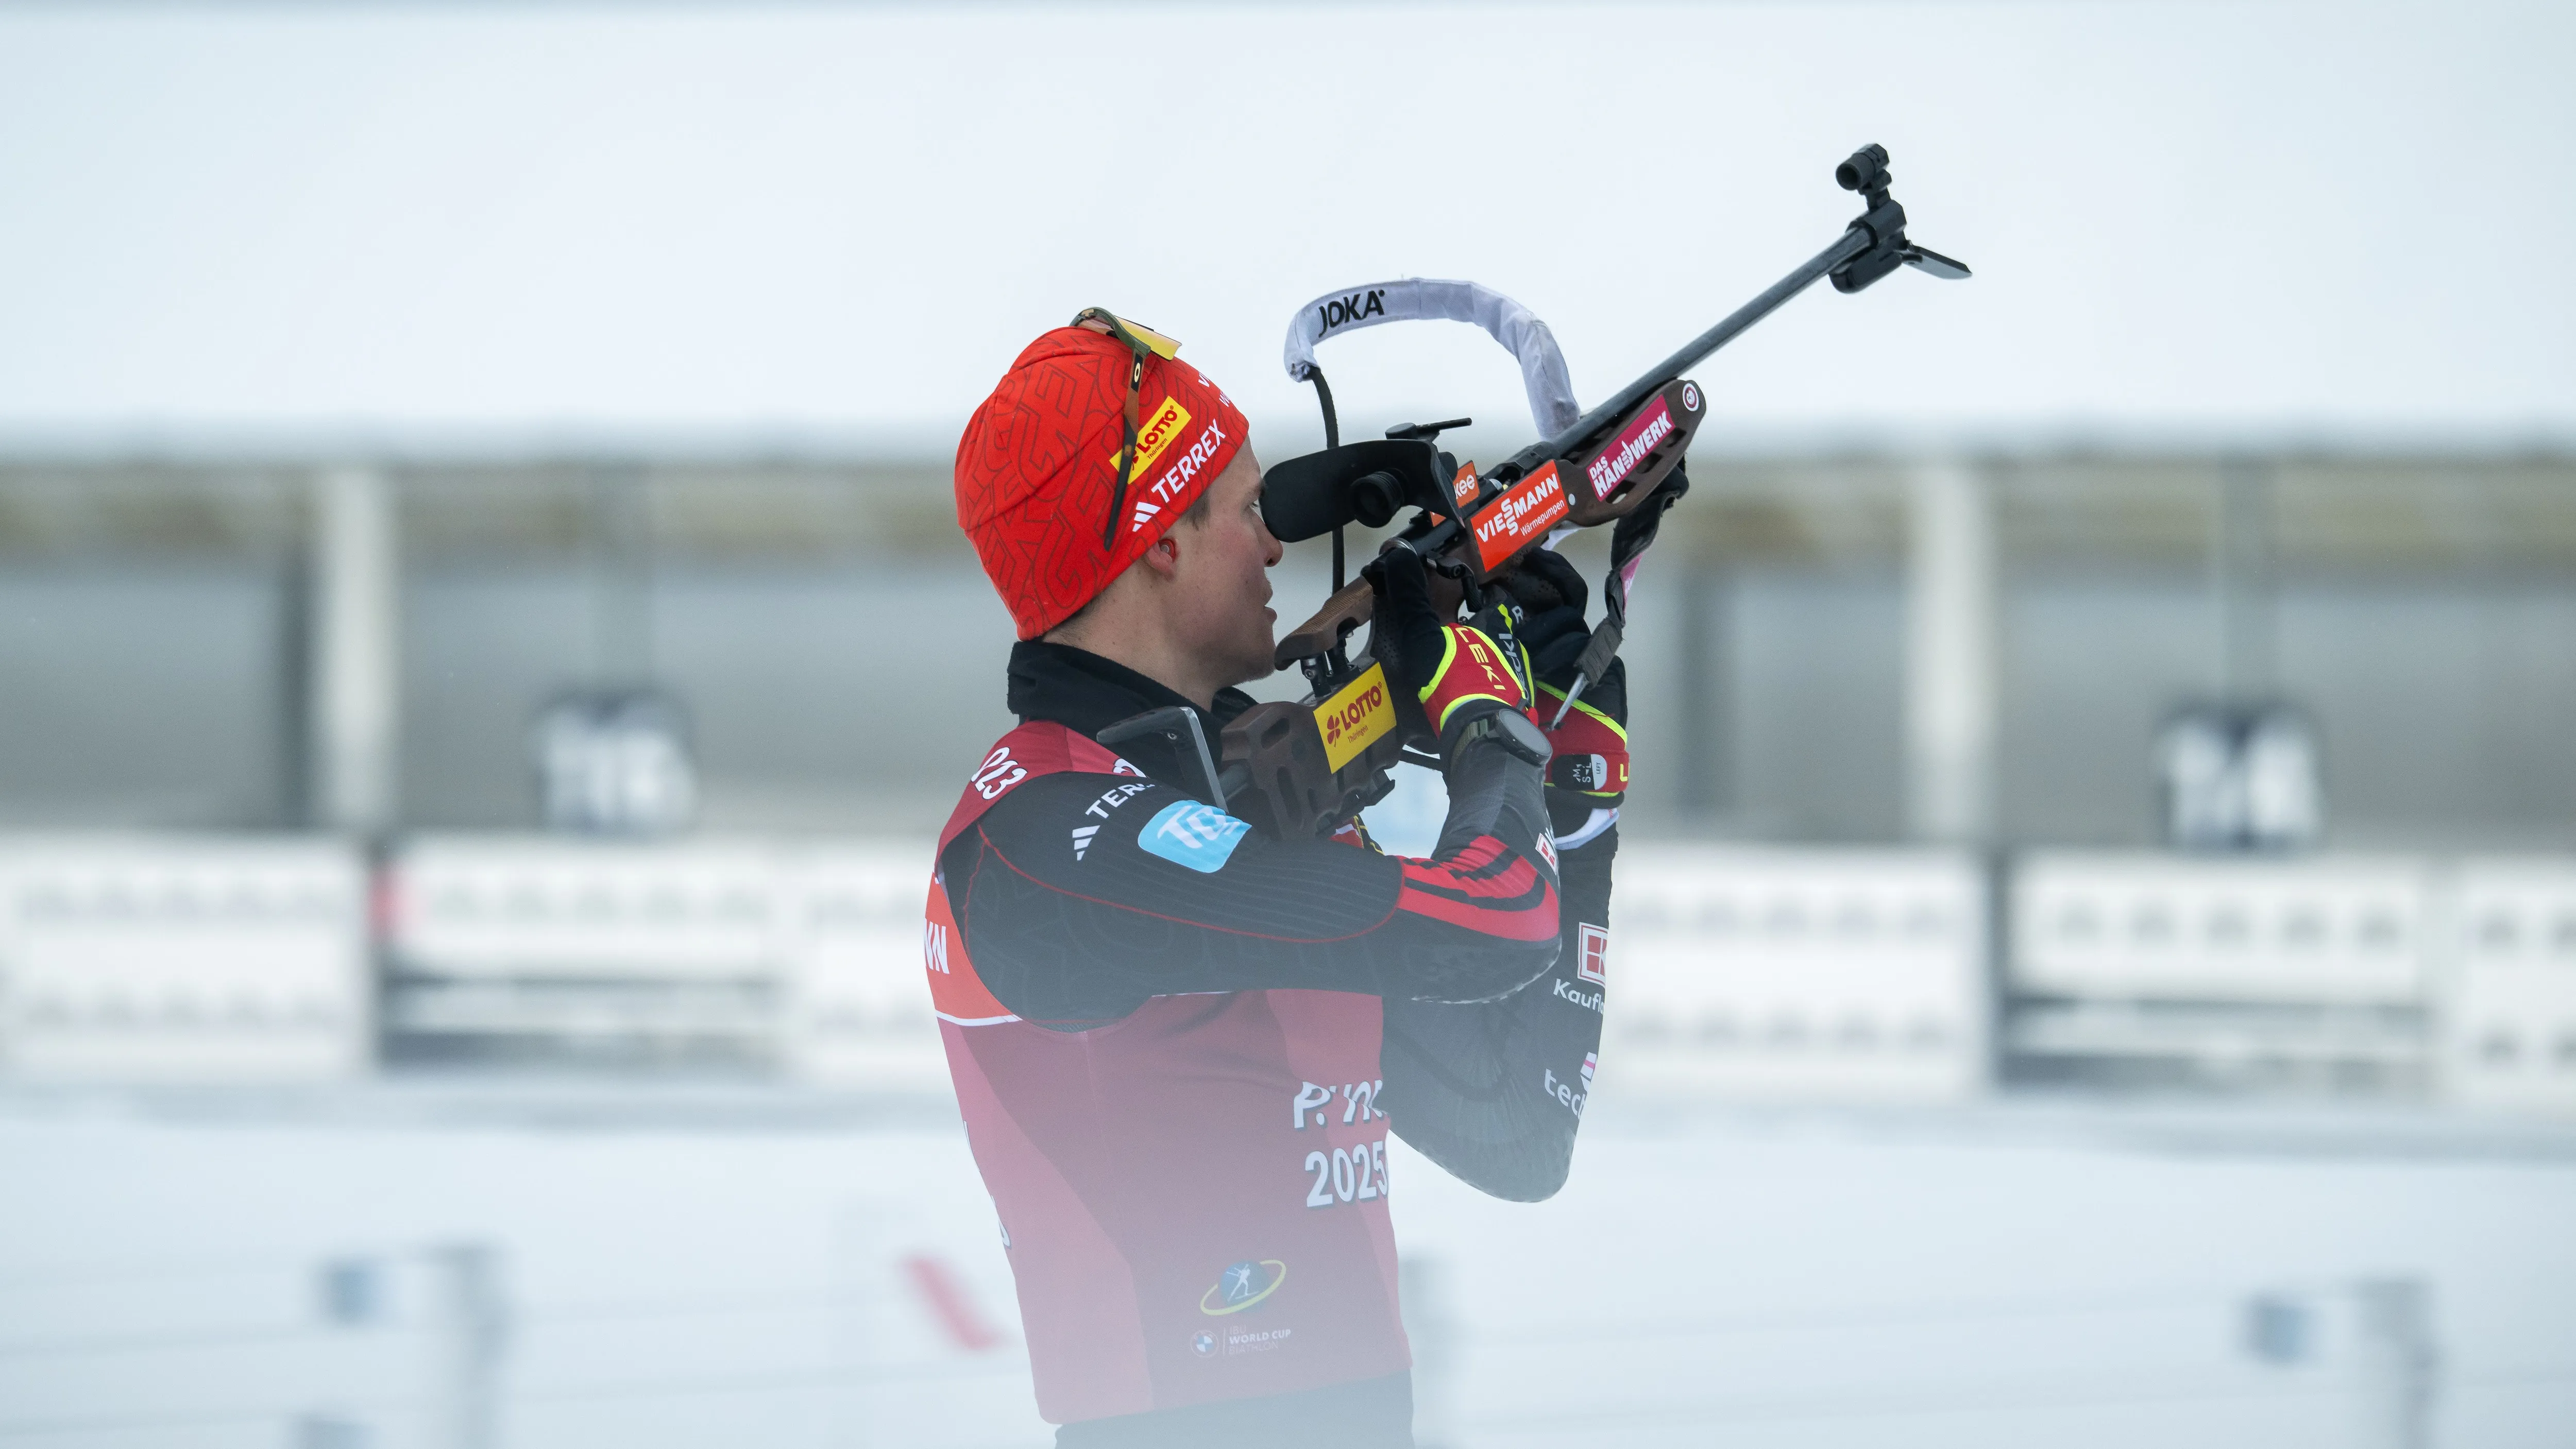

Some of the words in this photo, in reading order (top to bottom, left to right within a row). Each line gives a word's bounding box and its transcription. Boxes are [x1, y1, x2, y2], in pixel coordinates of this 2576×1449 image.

[1318, 291, 1384, 338] JOKA
[1151, 418, 1226, 503] TERREX
[1589, 456, 1608, 480] DAS
[1476, 473, 1560, 542] VIESSMANN
[1520, 500, 1565, 536] Wärmepumpen
[1455, 627, 1506, 690] LEKI
[1340, 686, 1382, 731] LOTTO
[1304, 1140, 1388, 1207] 2025
[1229, 1332, 1269, 1345] WORLD
[1272, 1328, 1292, 1339] CUP
